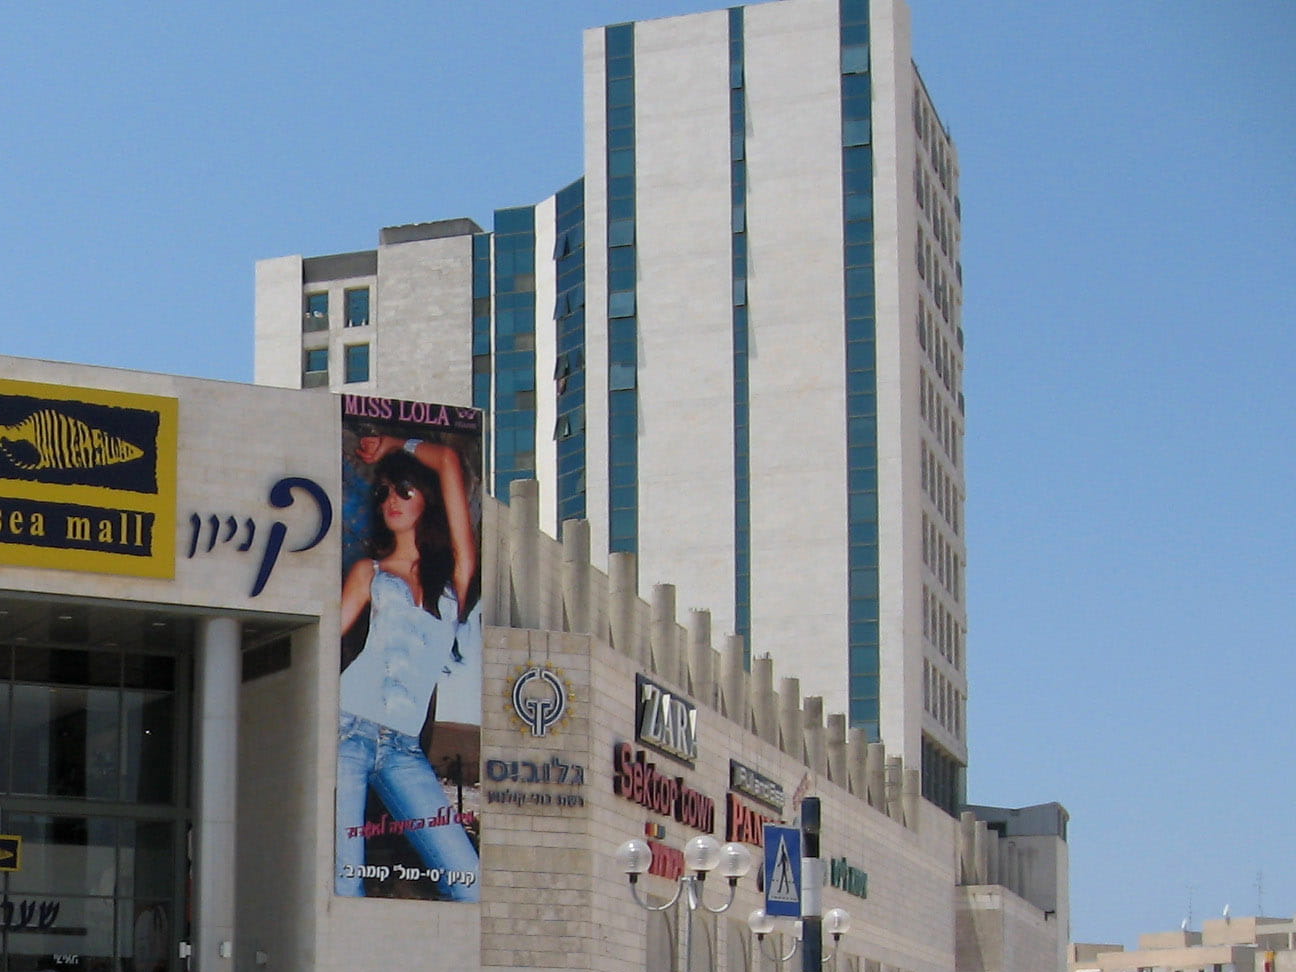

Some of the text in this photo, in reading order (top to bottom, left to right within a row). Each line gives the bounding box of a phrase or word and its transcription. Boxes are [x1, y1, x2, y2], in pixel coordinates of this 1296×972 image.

[344, 394, 450, 426] MISS LOLA
[66, 512, 144, 546] mall
[187, 477, 332, 597] קניון
[640, 683, 698, 760] ZARA
[357, 865, 389, 882] קומה
[447, 869, 476, 888] קניון
[0, 895, 60, 931] שער
